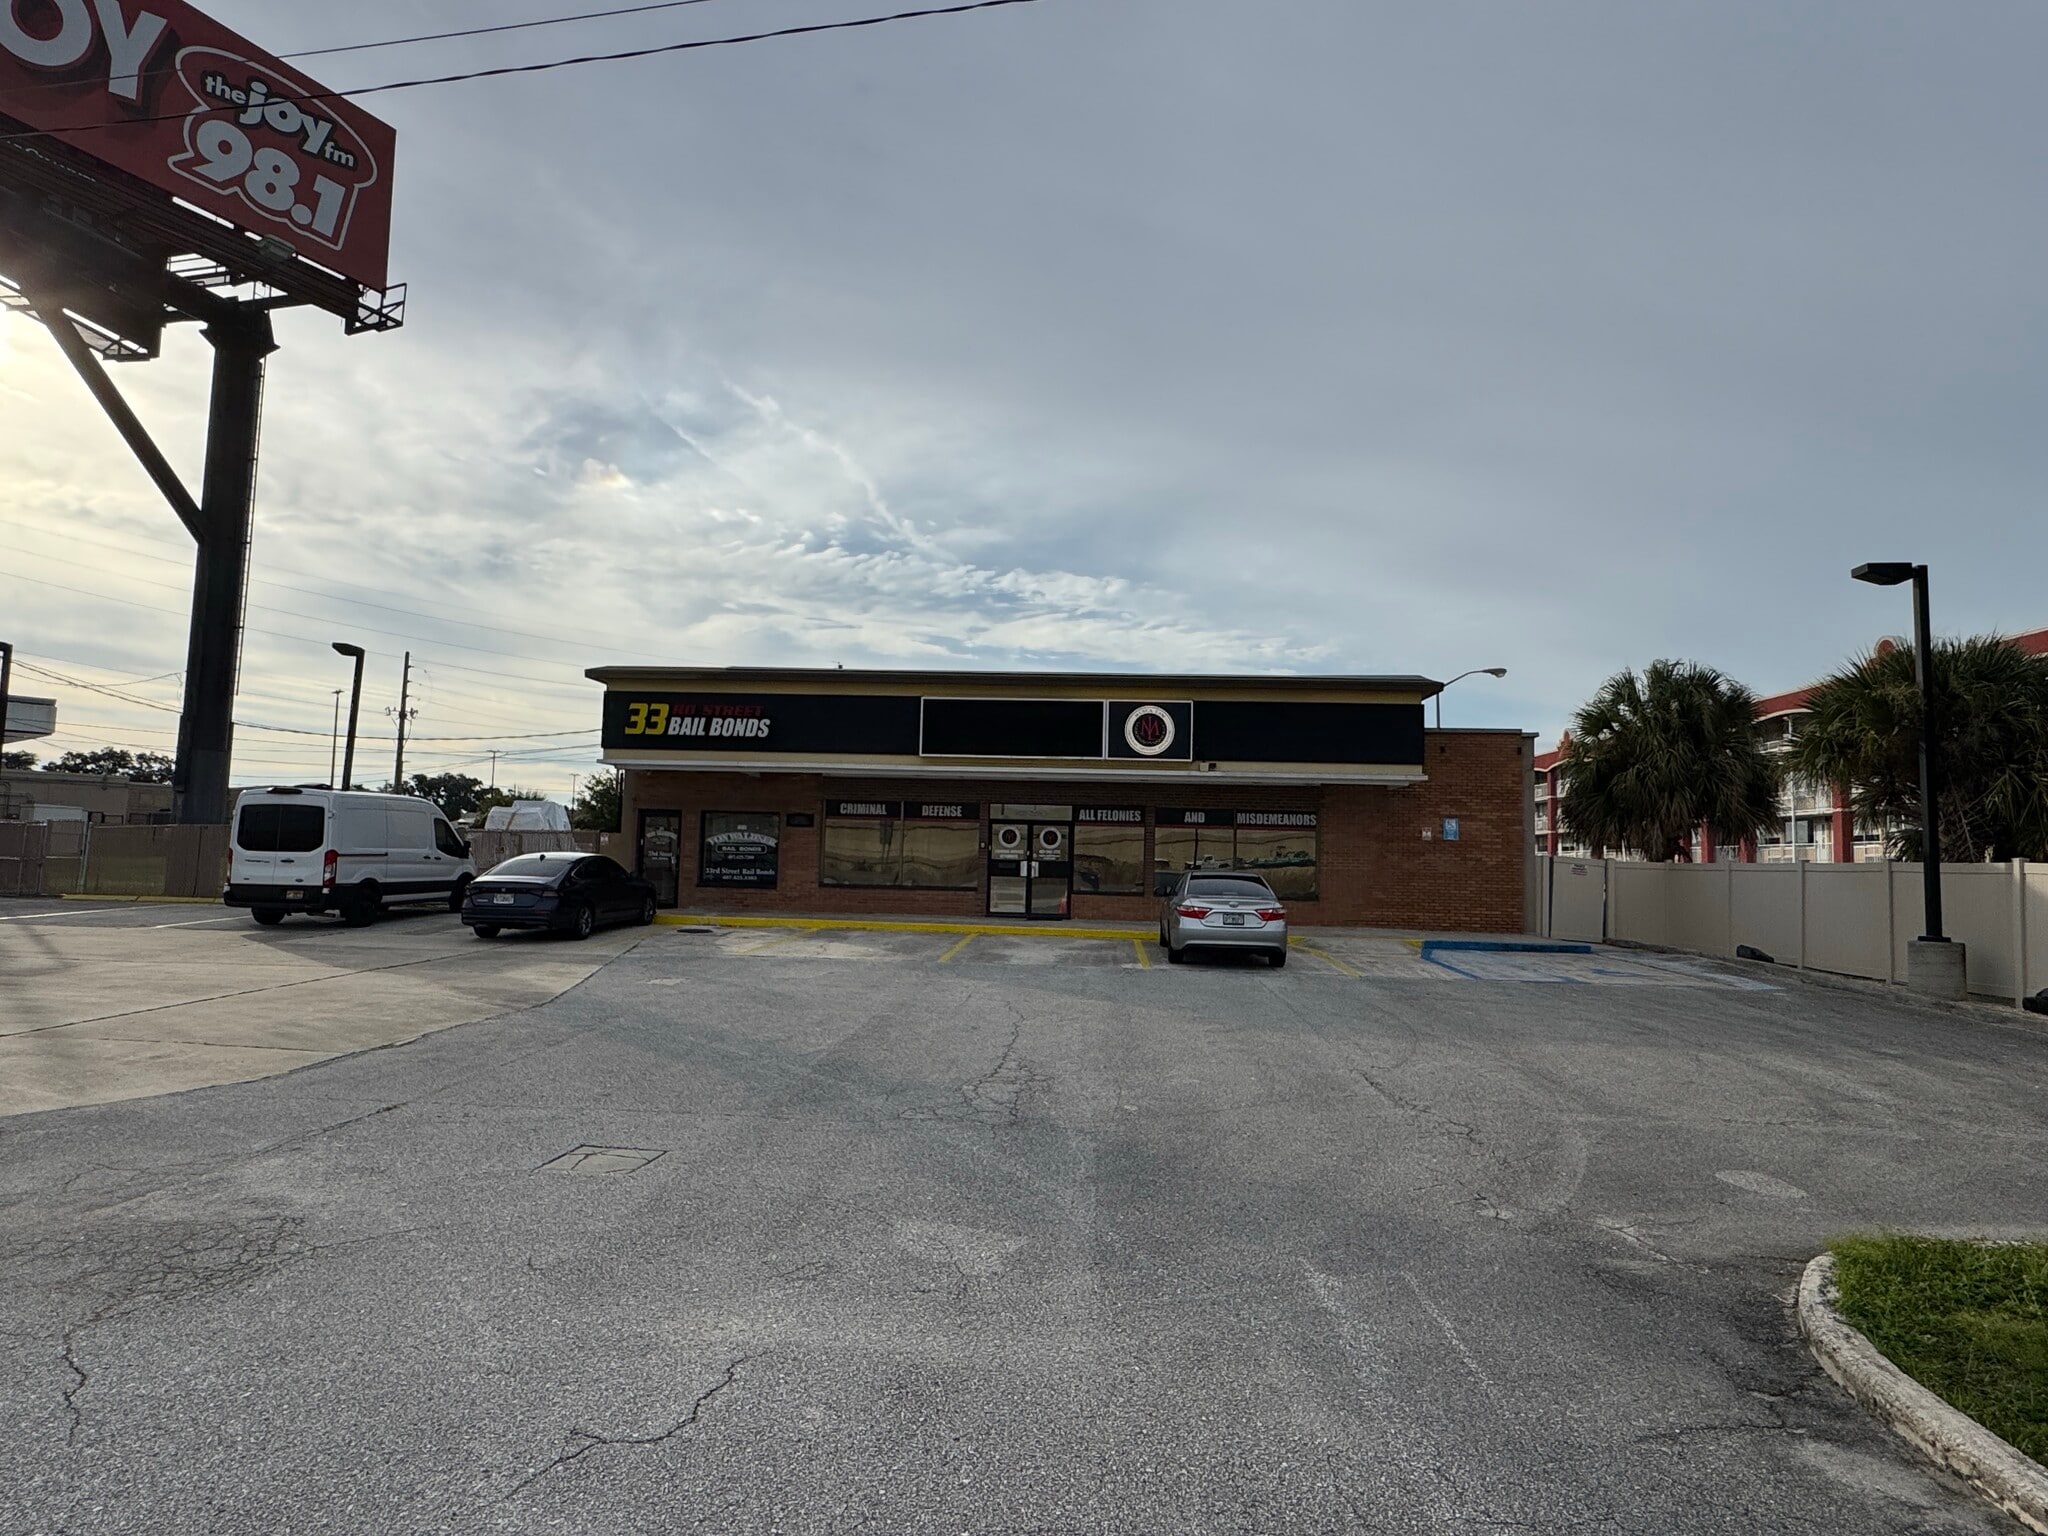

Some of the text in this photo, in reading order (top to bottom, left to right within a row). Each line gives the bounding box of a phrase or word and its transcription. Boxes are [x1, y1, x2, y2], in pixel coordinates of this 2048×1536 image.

[204, 73, 355, 168] the joy fm
[192, 119, 347, 238] 98.1
[624, 702, 670, 735] 33
[702, 704, 764, 716] STREET
[667, 716, 771, 738] BAIL BONDS
[839, 802, 888, 816] CRIMINAL
[921, 805, 963, 817] DEFENSE
[1078, 809, 1142, 822] ALL FELONIES
[1184, 811, 1206, 824] AND
[1236, 812, 1317, 826] MISDEMEANORS
[721, 867, 740, 875] Street
